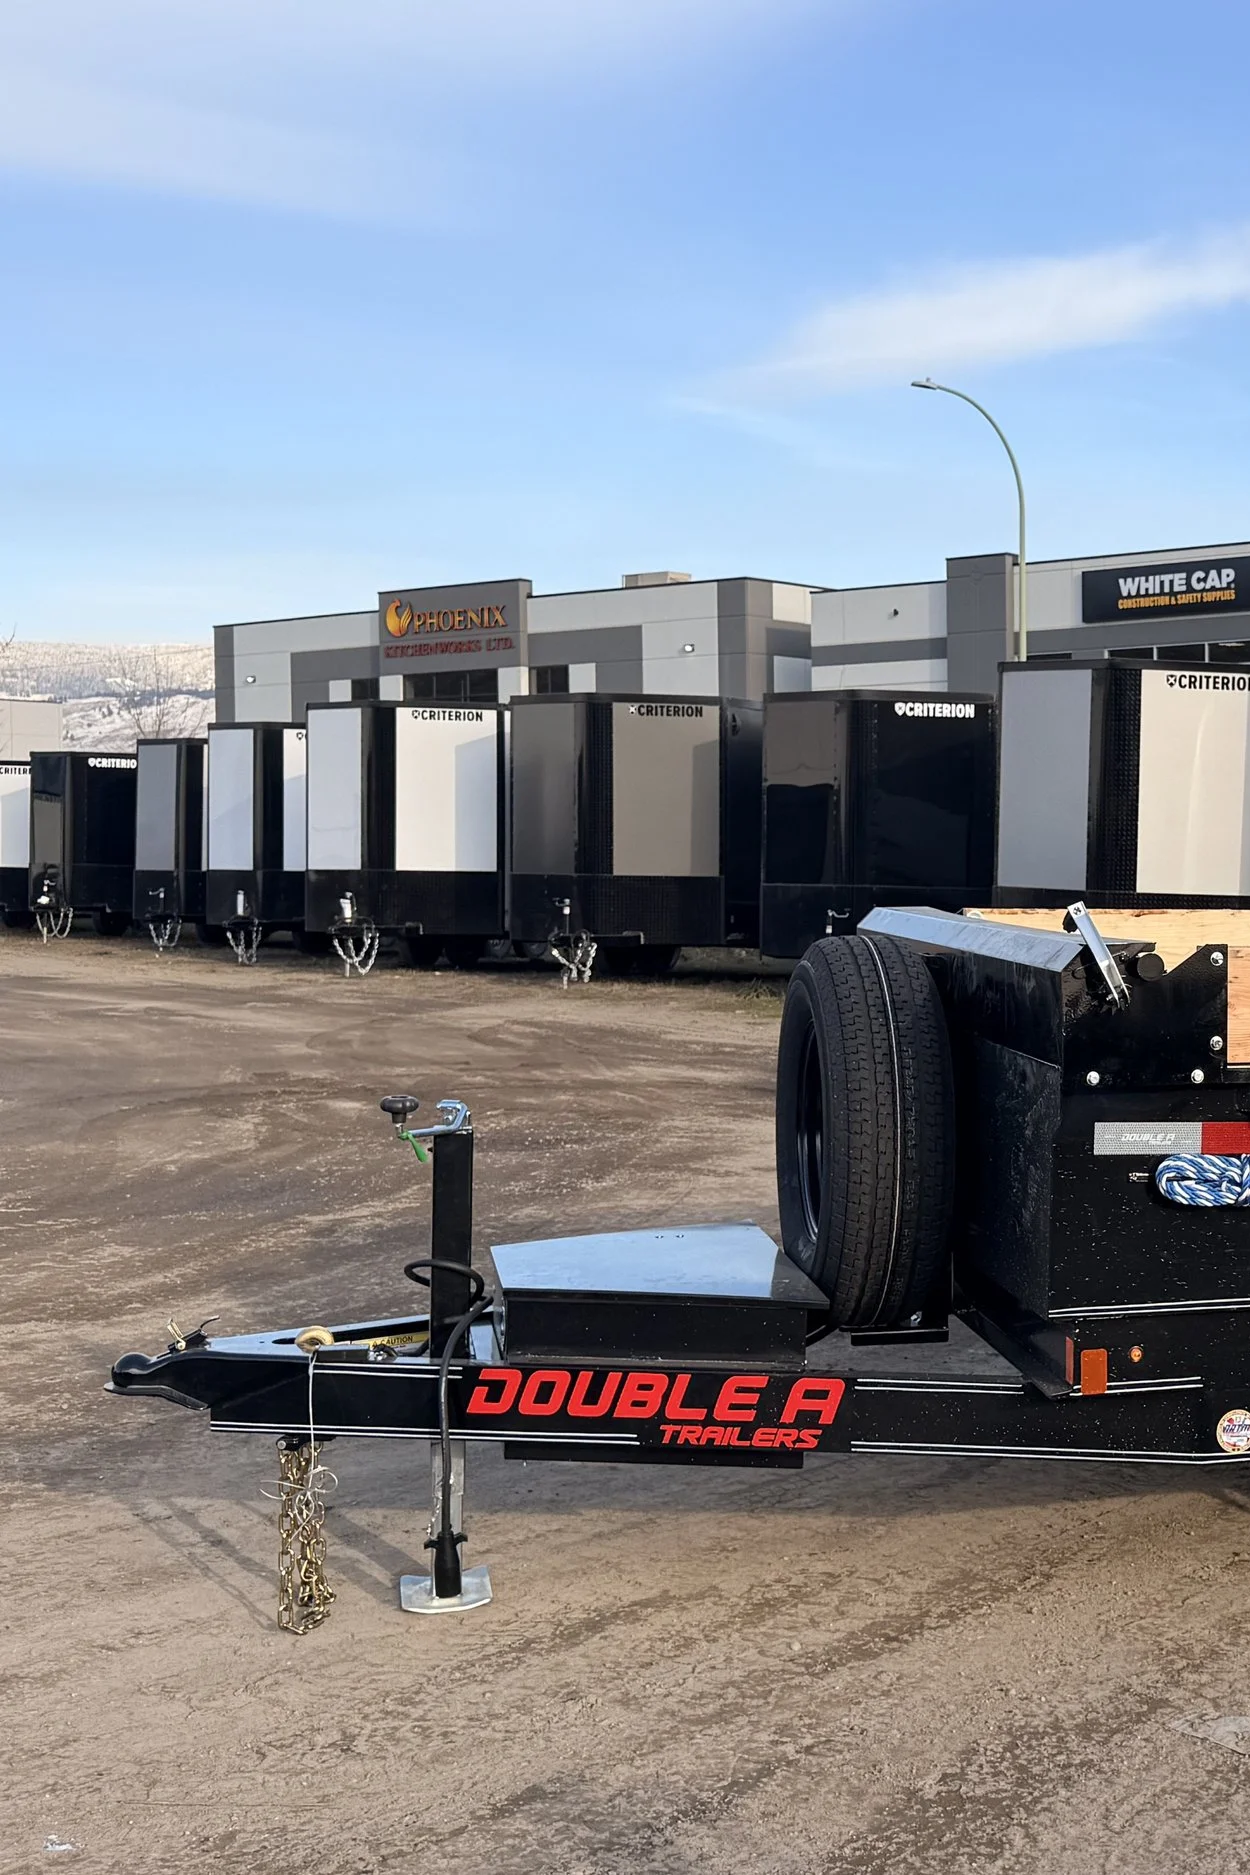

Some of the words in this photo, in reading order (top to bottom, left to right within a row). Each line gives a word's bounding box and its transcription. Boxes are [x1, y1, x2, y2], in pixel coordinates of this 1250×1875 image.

[1118, 572, 1187, 597] WHITE
[1118, 594, 1170, 609] CONSTRUCTION
[1171, 598, 1176, 606] &
[1177, 593, 1202, 604] SAFETY
[1203, 589, 1236, 603] SUPPLIES
[413, 605, 508, 634] PHOENIX
[385, 640, 482, 659] KITCHENWORKS
[486, 637, 515, 652] LTD.
[421, 709, 483, 722] CRITERION
[637, 704, 703, 718] CRITERION
[905, 702, 975, 719] CRITERION
[380, 1335, 413, 1347] CAUTION
[466, 1368, 770, 1422] DOUBLE
[779, 1378, 846, 1425] A
[659, 1425, 823, 1450] TRAILERS
